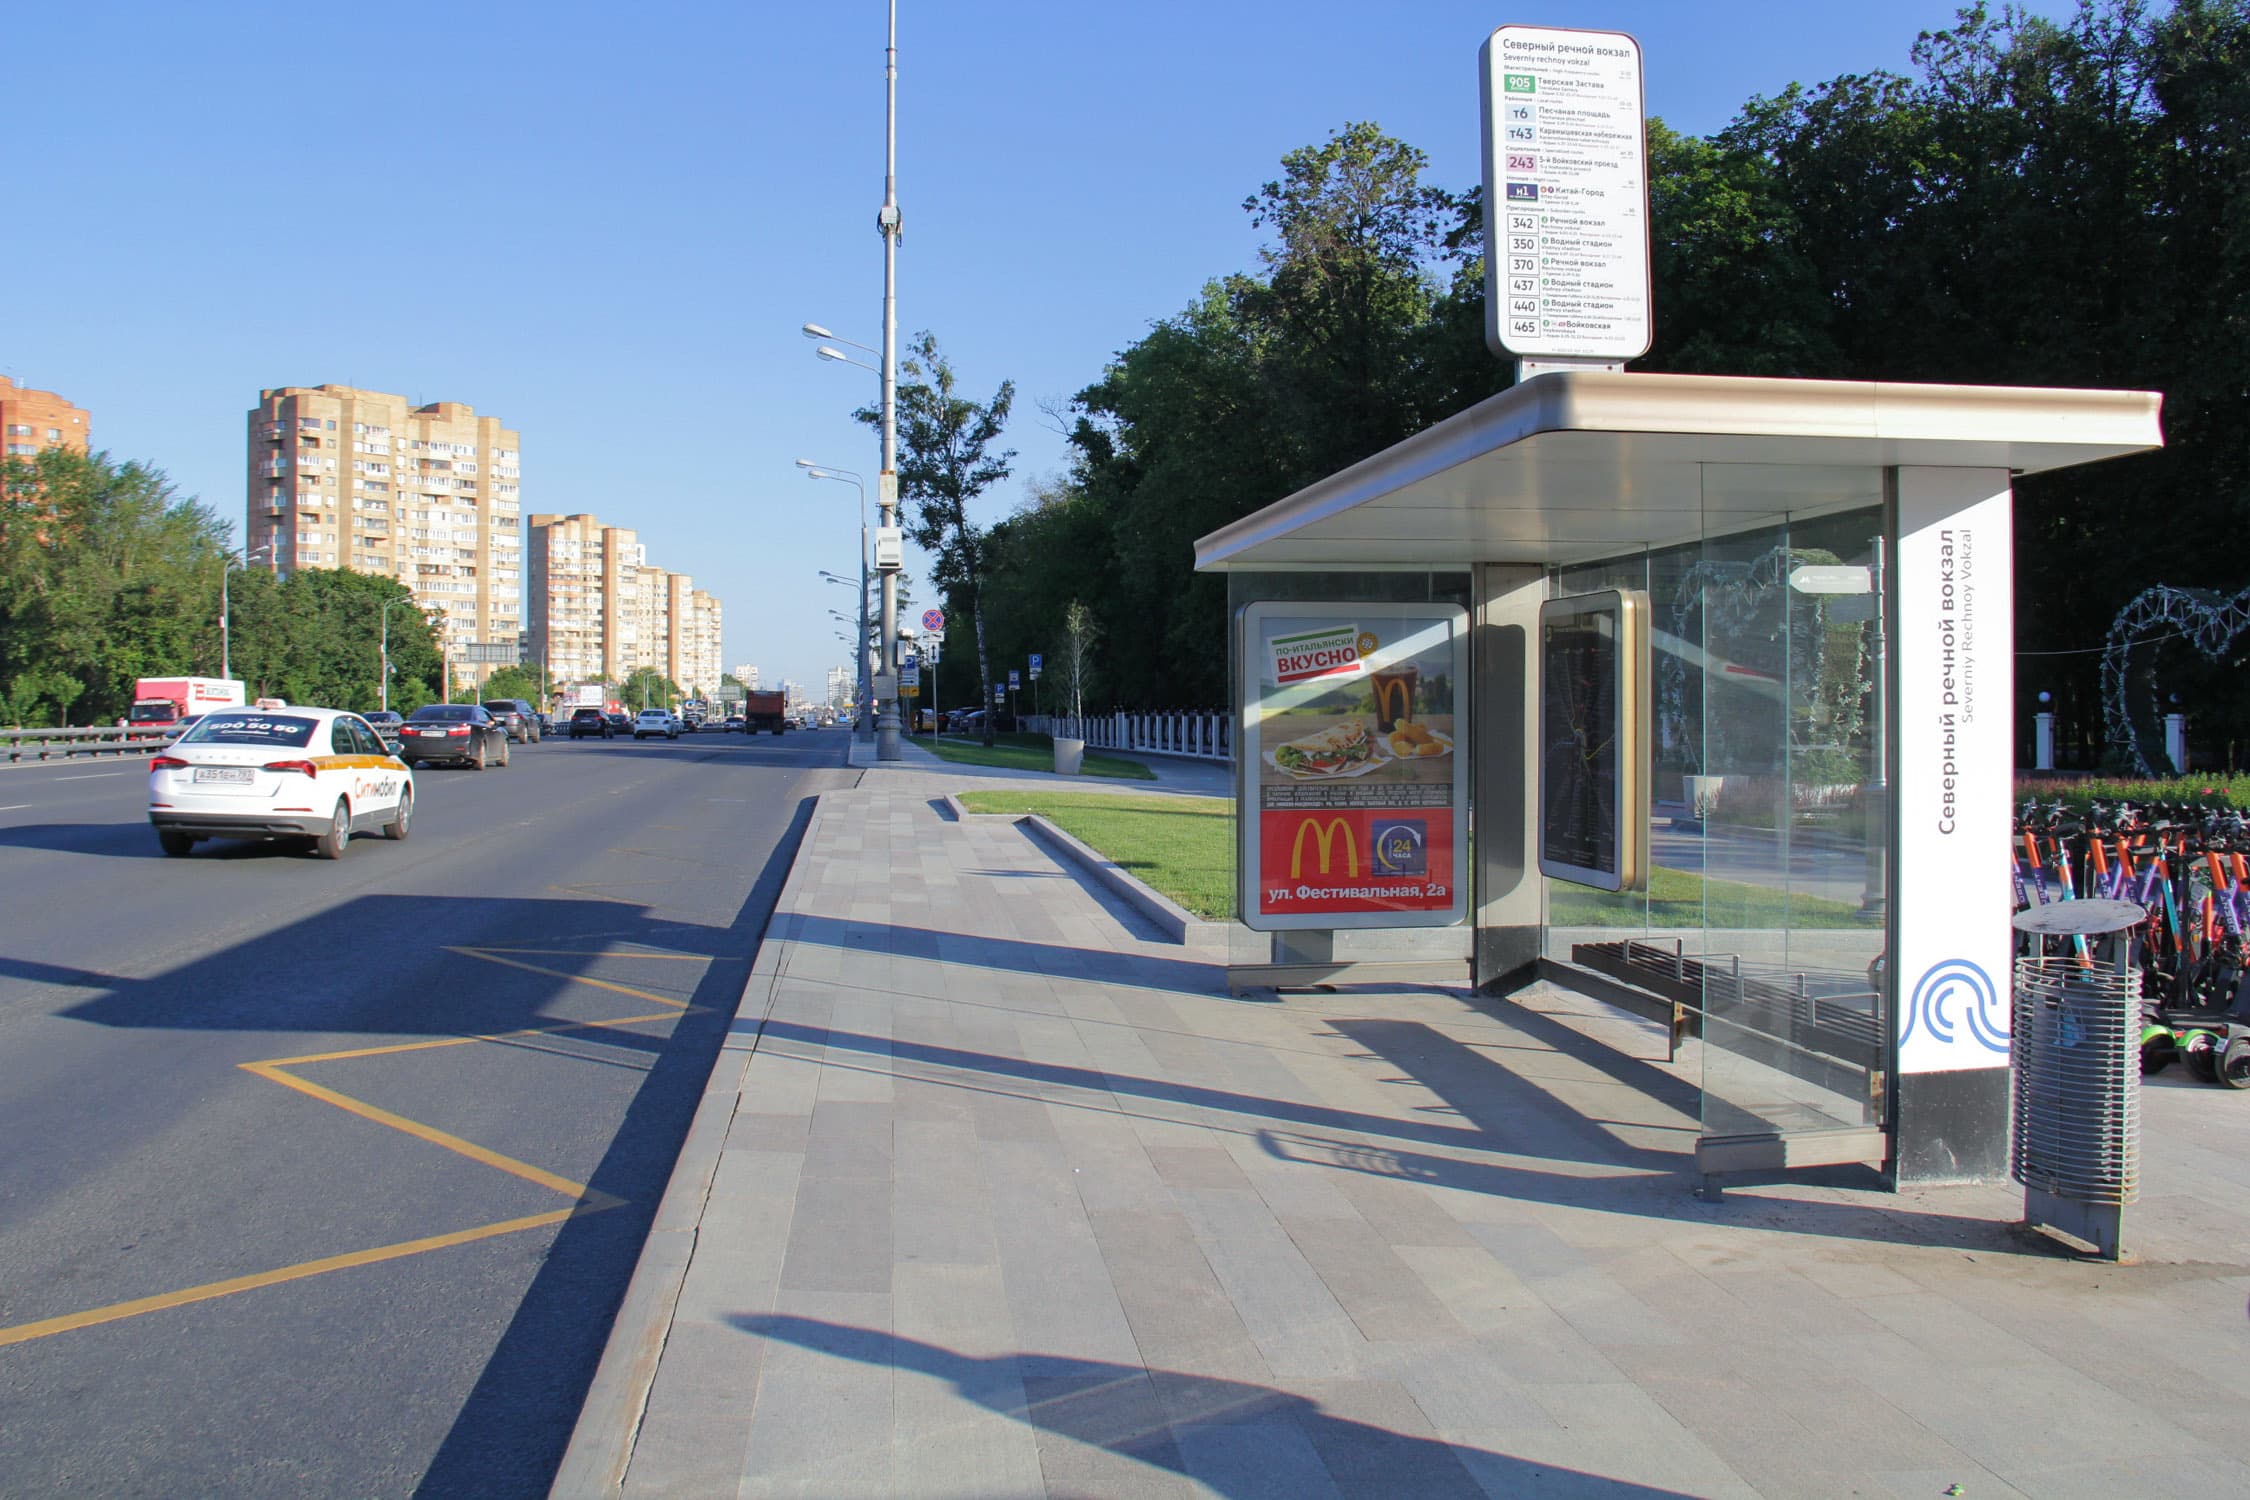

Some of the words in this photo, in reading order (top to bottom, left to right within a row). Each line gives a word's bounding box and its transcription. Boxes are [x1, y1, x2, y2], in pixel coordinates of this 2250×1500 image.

[1503, 38, 1555, 52] Северный
[1557, 44, 1594, 55] речной
[1596, 49, 1631, 58] вокзал
[1504, 53, 1535, 62] Severniy
[1536, 56, 1566, 66] rechnoy
[1509, 77, 1531, 88] 905
[1538, 77, 1574, 87] Тверская
[1576, 80, 1605, 88] Застава
[1538, 106, 1576, 116] Песчаная
[1577, 110, 1611, 119] площадь
[1539, 127, 1592, 138] Карамышевская
[1594, 131, 1632, 140] набережная
[1509, 156, 1534, 169] 243
[1552, 157, 1593, 166] Войковский
[1594, 161, 1619, 169] проезд
[1556, 188, 1605, 198] Китай-Город
[1512, 218, 1534, 229] 342
[1550, 216, 1578, 225] Речной
[1513, 238, 1535, 250] 350
[1550, 238, 1581, 246] Водный
[1582, 240, 1613, 248] стадион
[1514, 259, 1534, 271] 370
[1550, 258, 1579, 266] Речной
[1514, 280, 1534, 291] 437
[1551, 278, 1582, 287] Водный
[1582, 281, 1614, 289] стадион
[1514, 301, 1536, 312] 440
[1552, 300, 1582, 308] Водный
[1583, 302, 1614, 310] стадион
[1514, 322, 1536, 333] 465
[1566, 321, 1612, 330] Войковская
[1960, 529, 1973, 580] Vokzal
[1941, 530, 1955, 611] вокзал
[1961, 584, 1975, 651] Rechnoy
[1275, 636, 1354, 656] ПО-ИТАЛЬЯНСКИ
[1277, 646, 1357, 673] ВКУСНО
[1938, 619, 1959, 706] речной
[1962, 656, 1976, 723] Severniy
[208, 722, 246, 730] 500
[247, 722, 273, 730] 50
[273, 724, 298, 734] 50
[1938, 713, 1959, 835] Северный
[354, 776, 398, 800] Ситимобил
[1392, 840, 1411, 853] 24
[1268, 888, 1293, 904] ул.
[1296, 884, 1424, 900] Фестивальная,
[1426, 883, 1447, 897] 2а
